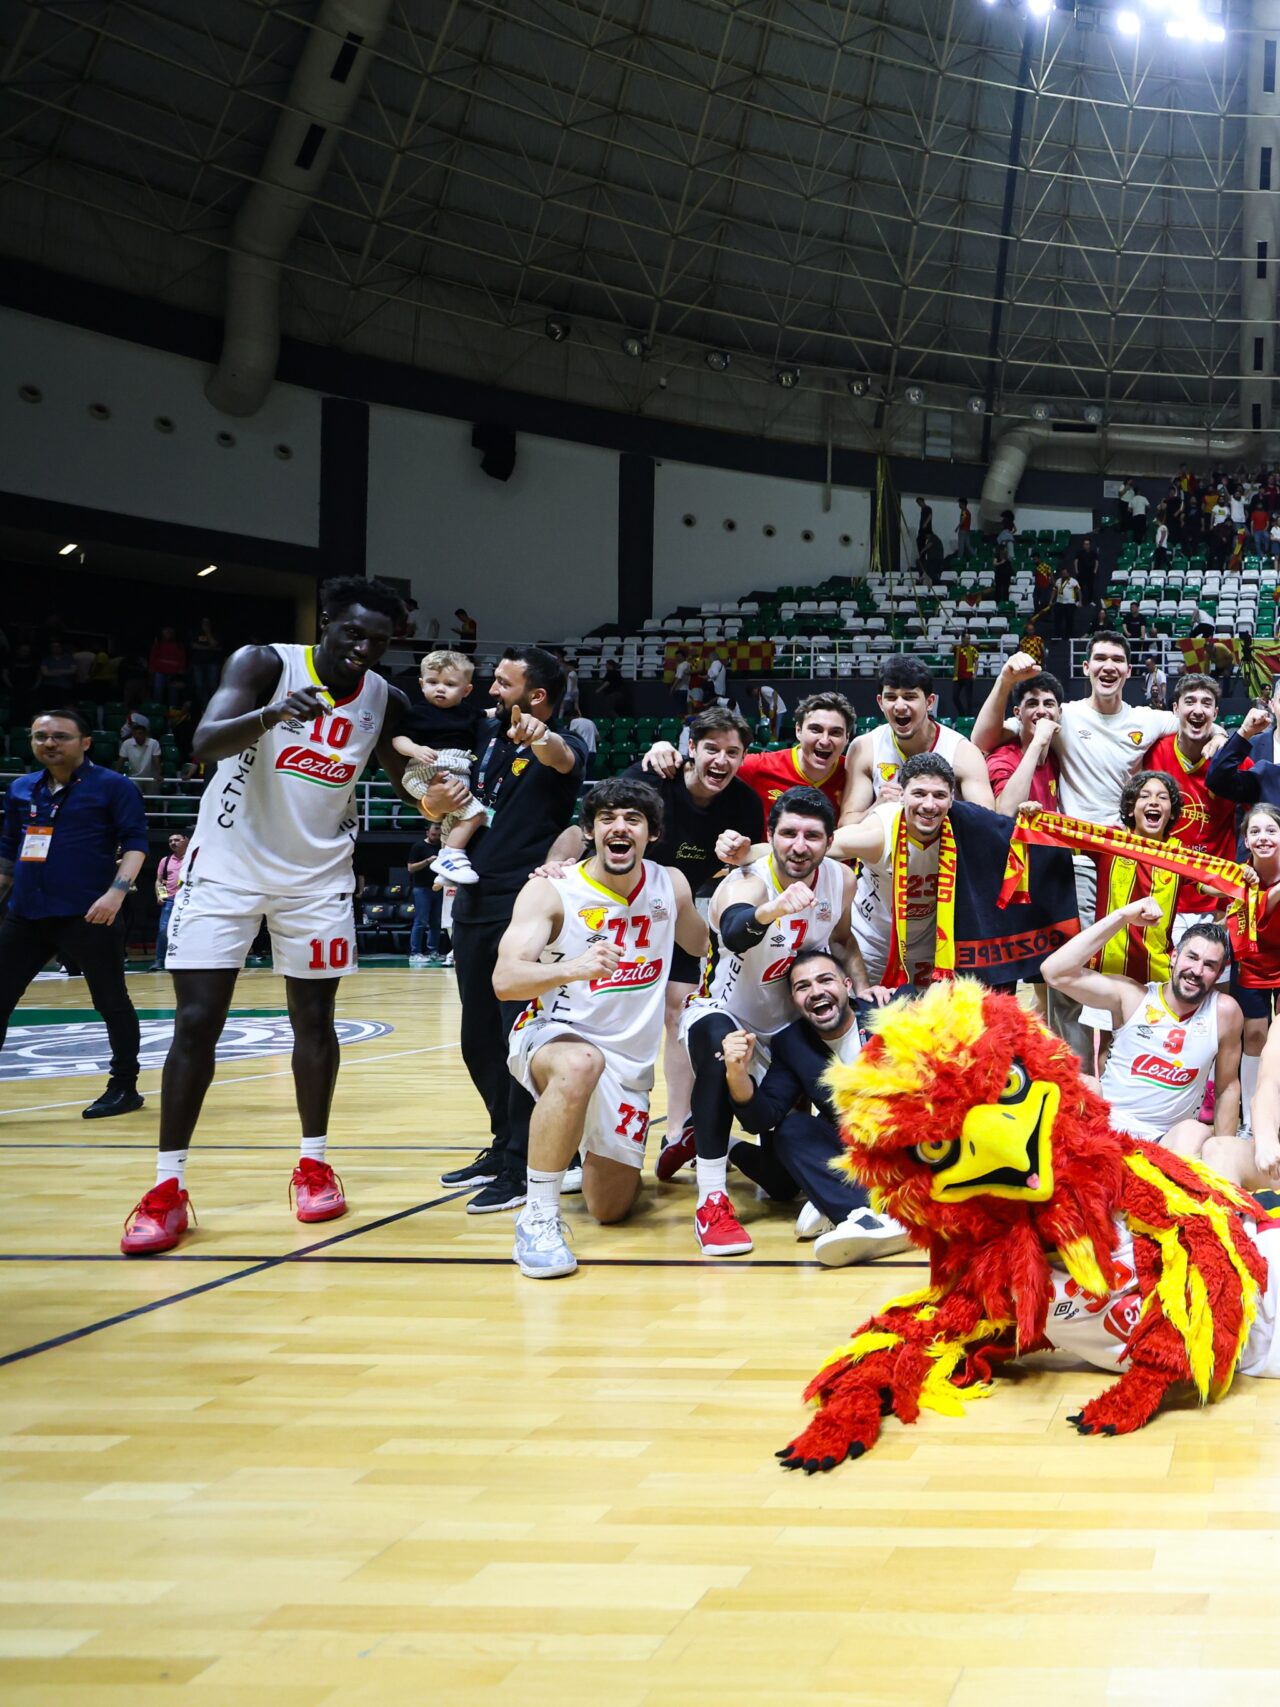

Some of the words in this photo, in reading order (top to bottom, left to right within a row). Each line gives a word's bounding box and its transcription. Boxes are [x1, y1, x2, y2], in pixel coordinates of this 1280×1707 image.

[308, 714, 354, 750] 10
[283, 747, 349, 779] Lezita
[906, 873, 938, 899] 23
[607, 914, 652, 950] 77
[789, 918, 808, 951] 7
[308, 937, 350, 970] 10
[1136, 1054, 1192, 1083] Lezita
[614, 1102, 650, 1144] 77
